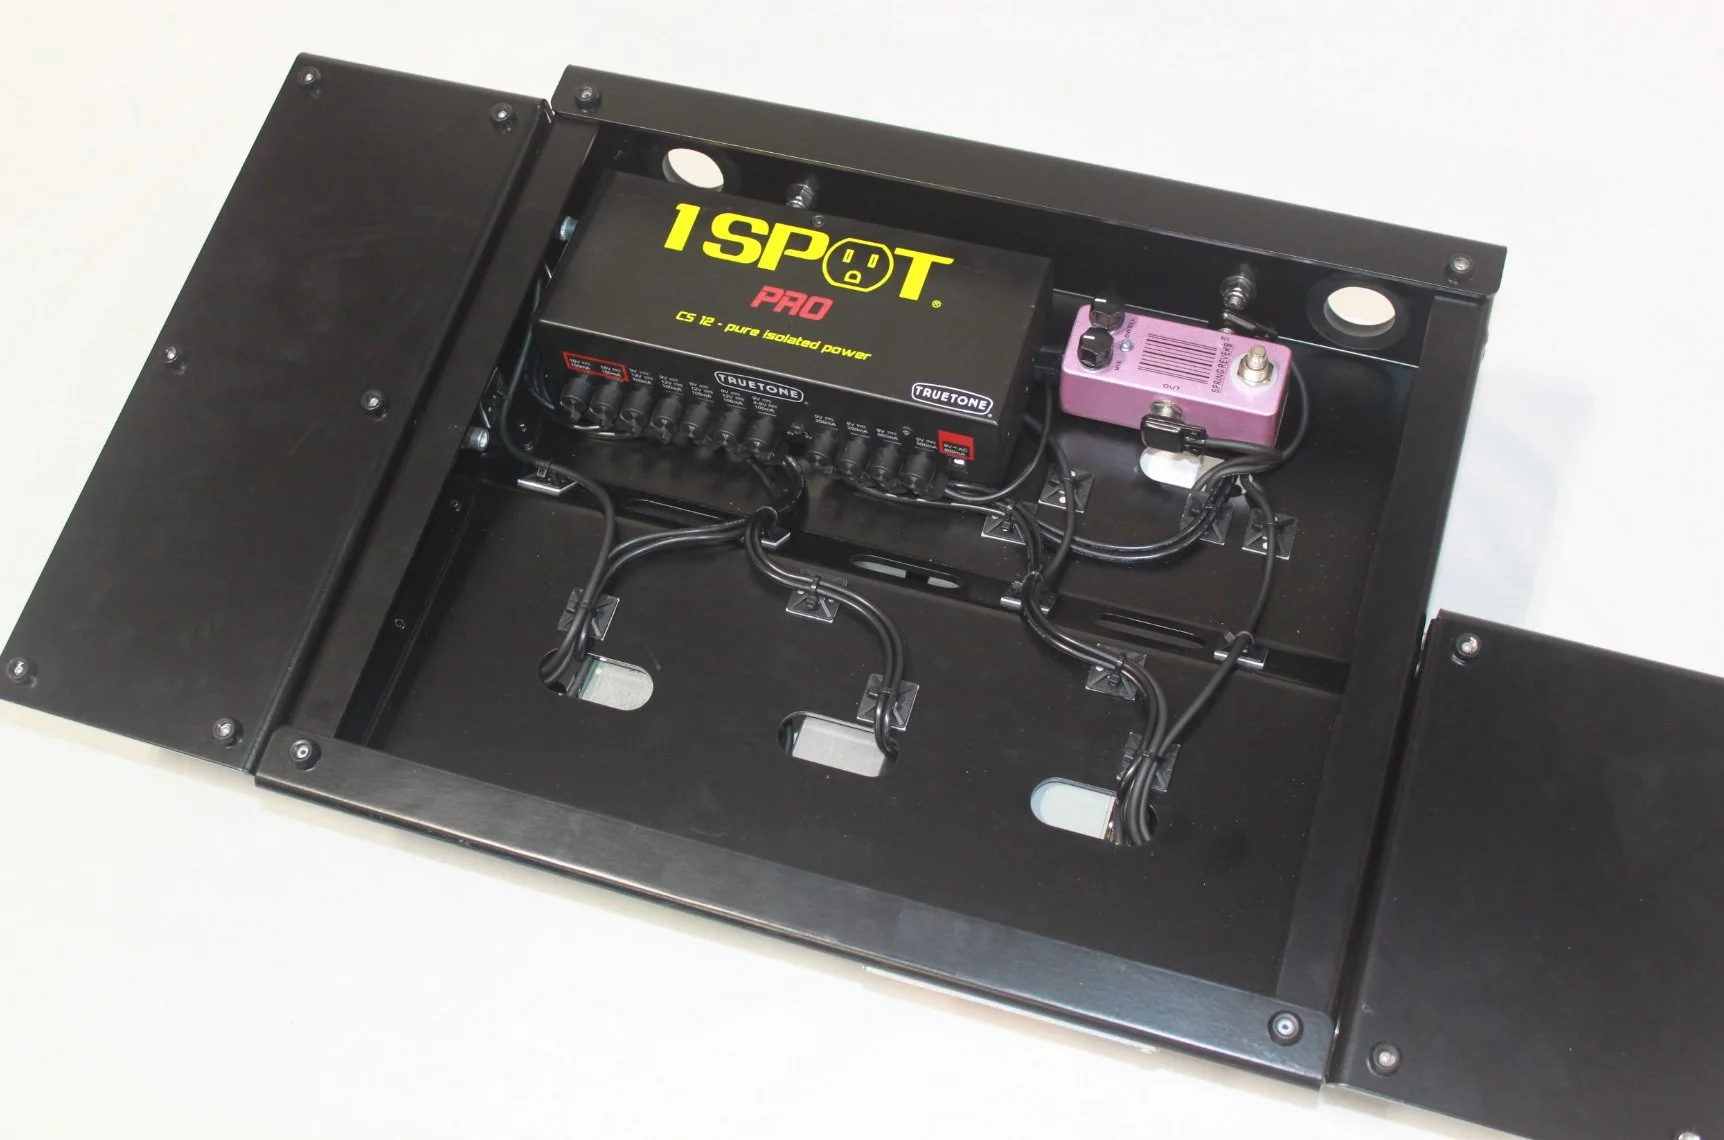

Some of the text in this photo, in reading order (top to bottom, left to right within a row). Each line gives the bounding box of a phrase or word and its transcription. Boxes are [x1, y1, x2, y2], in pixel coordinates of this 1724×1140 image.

[664, 203, 700, 251] 1
[750, 285, 834, 321] PRO
[675, 310, 697, 323] CS
[699, 315, 715, 327] 12
[724, 322, 760, 337] pure
[762, 329, 821, 349] isolated
[821, 344, 872, 361] power
[1210, 342, 1233, 393] SPRING REVERB
[718, 373, 799, 399] TRUETONE
[915, 385, 988, 411] TRUETONE
[1163, 383, 1182, 391] OUT
